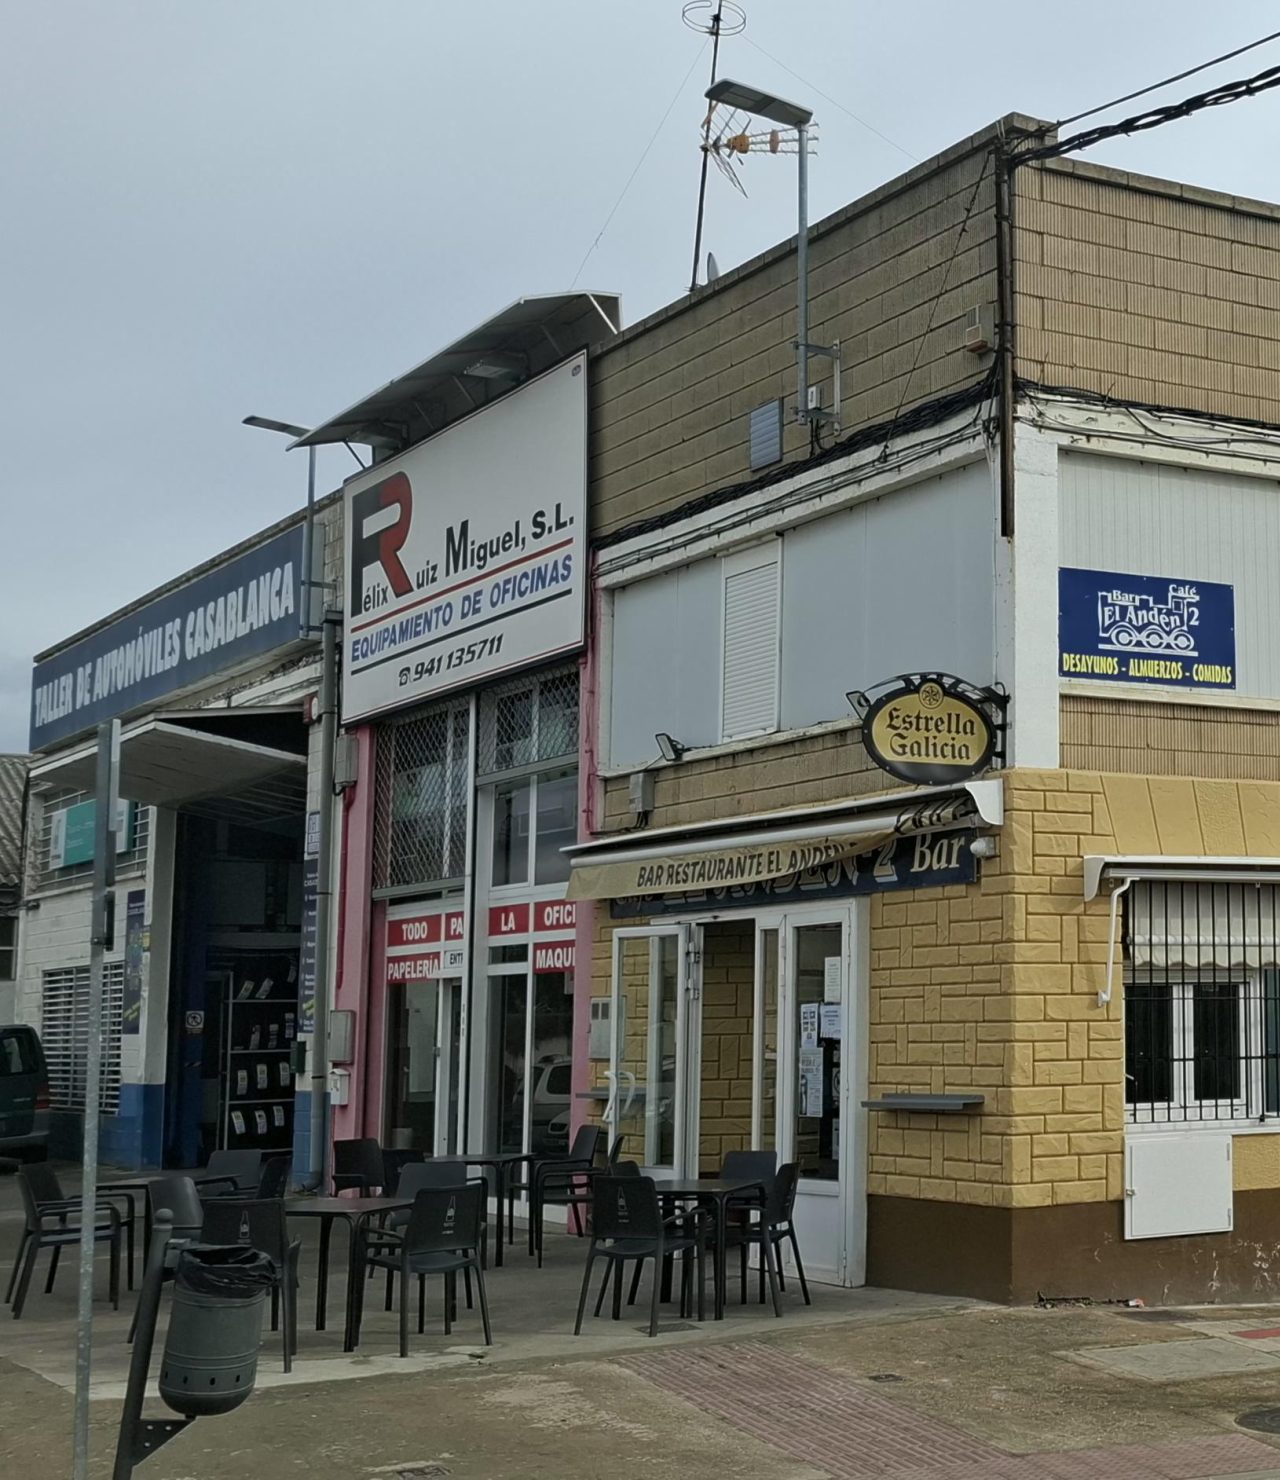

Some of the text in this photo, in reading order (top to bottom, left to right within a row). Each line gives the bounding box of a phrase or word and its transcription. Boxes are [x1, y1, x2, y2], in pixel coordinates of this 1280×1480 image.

[445, 519, 526, 578] Miguel,
[531, 502, 574, 540] S.L.
[1112, 590, 1137, 602] Bar
[1169, 584, 1197, 598] Café
[351, 554, 572, 662] EQUIPAMIENTO DE OFICINAS
[1104, 606, 1199, 631] El Andén 2
[35, 561, 295, 728] TALLER DE AUTOMÓVILES CASABLANCA
[1063, 653, 1118, 675] DESAYUNOS
[1129, 658, 1183, 679] ALMUERZOS
[1192, 664, 1232, 684] COMIDAS
[886, 707, 976, 736] Estrella
[890, 733, 971, 760] Galicia
[910, 833, 966, 872] Bar
[637, 865, 664, 887] BAR
[666, 853, 763, 886] RESTAURANTE
[767, 850, 782, 873] EL
[402, 921, 428, 941] TODO
[501, 912, 515, 932] LA
[388, 955, 441, 980] PAPELERÍA
